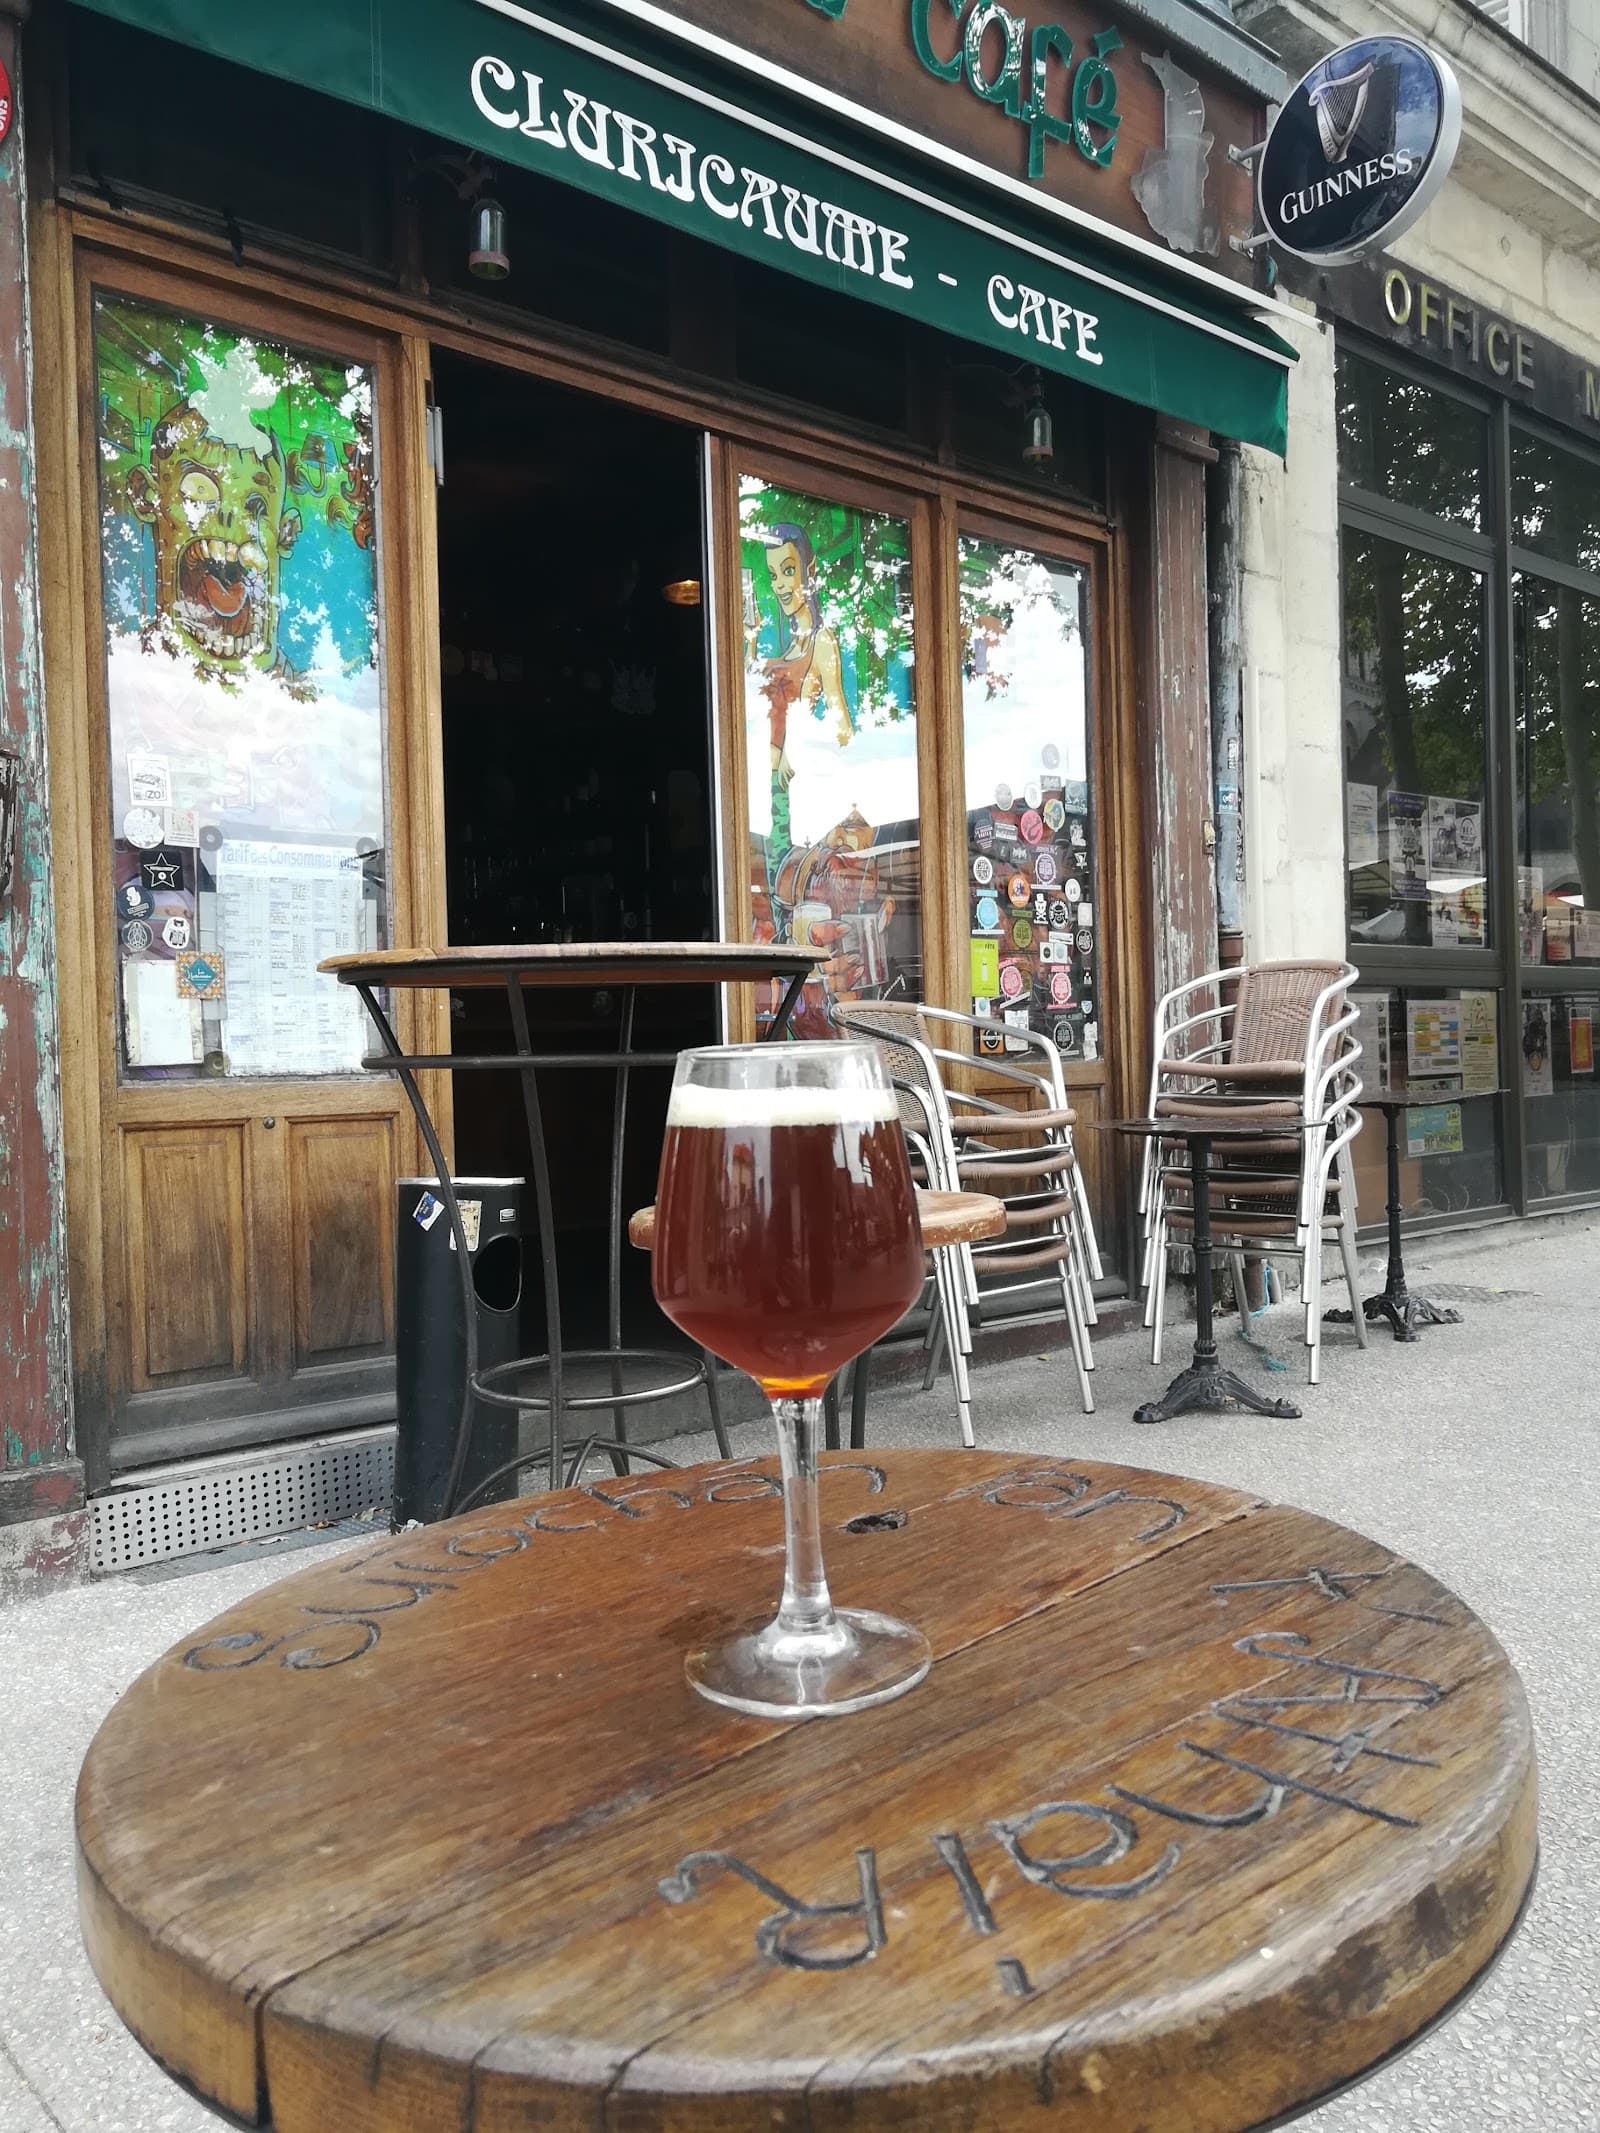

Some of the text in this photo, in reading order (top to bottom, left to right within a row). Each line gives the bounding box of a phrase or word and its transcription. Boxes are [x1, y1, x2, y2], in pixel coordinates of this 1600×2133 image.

[910, 0, 1124, 178] Café
[1280, 148, 1413, 225] GUINNESS
[986, 274, 1104, 365] CAFE
[1384, 268, 1535, 390] OFFICE
[988, 1471, 1188, 1542] an
